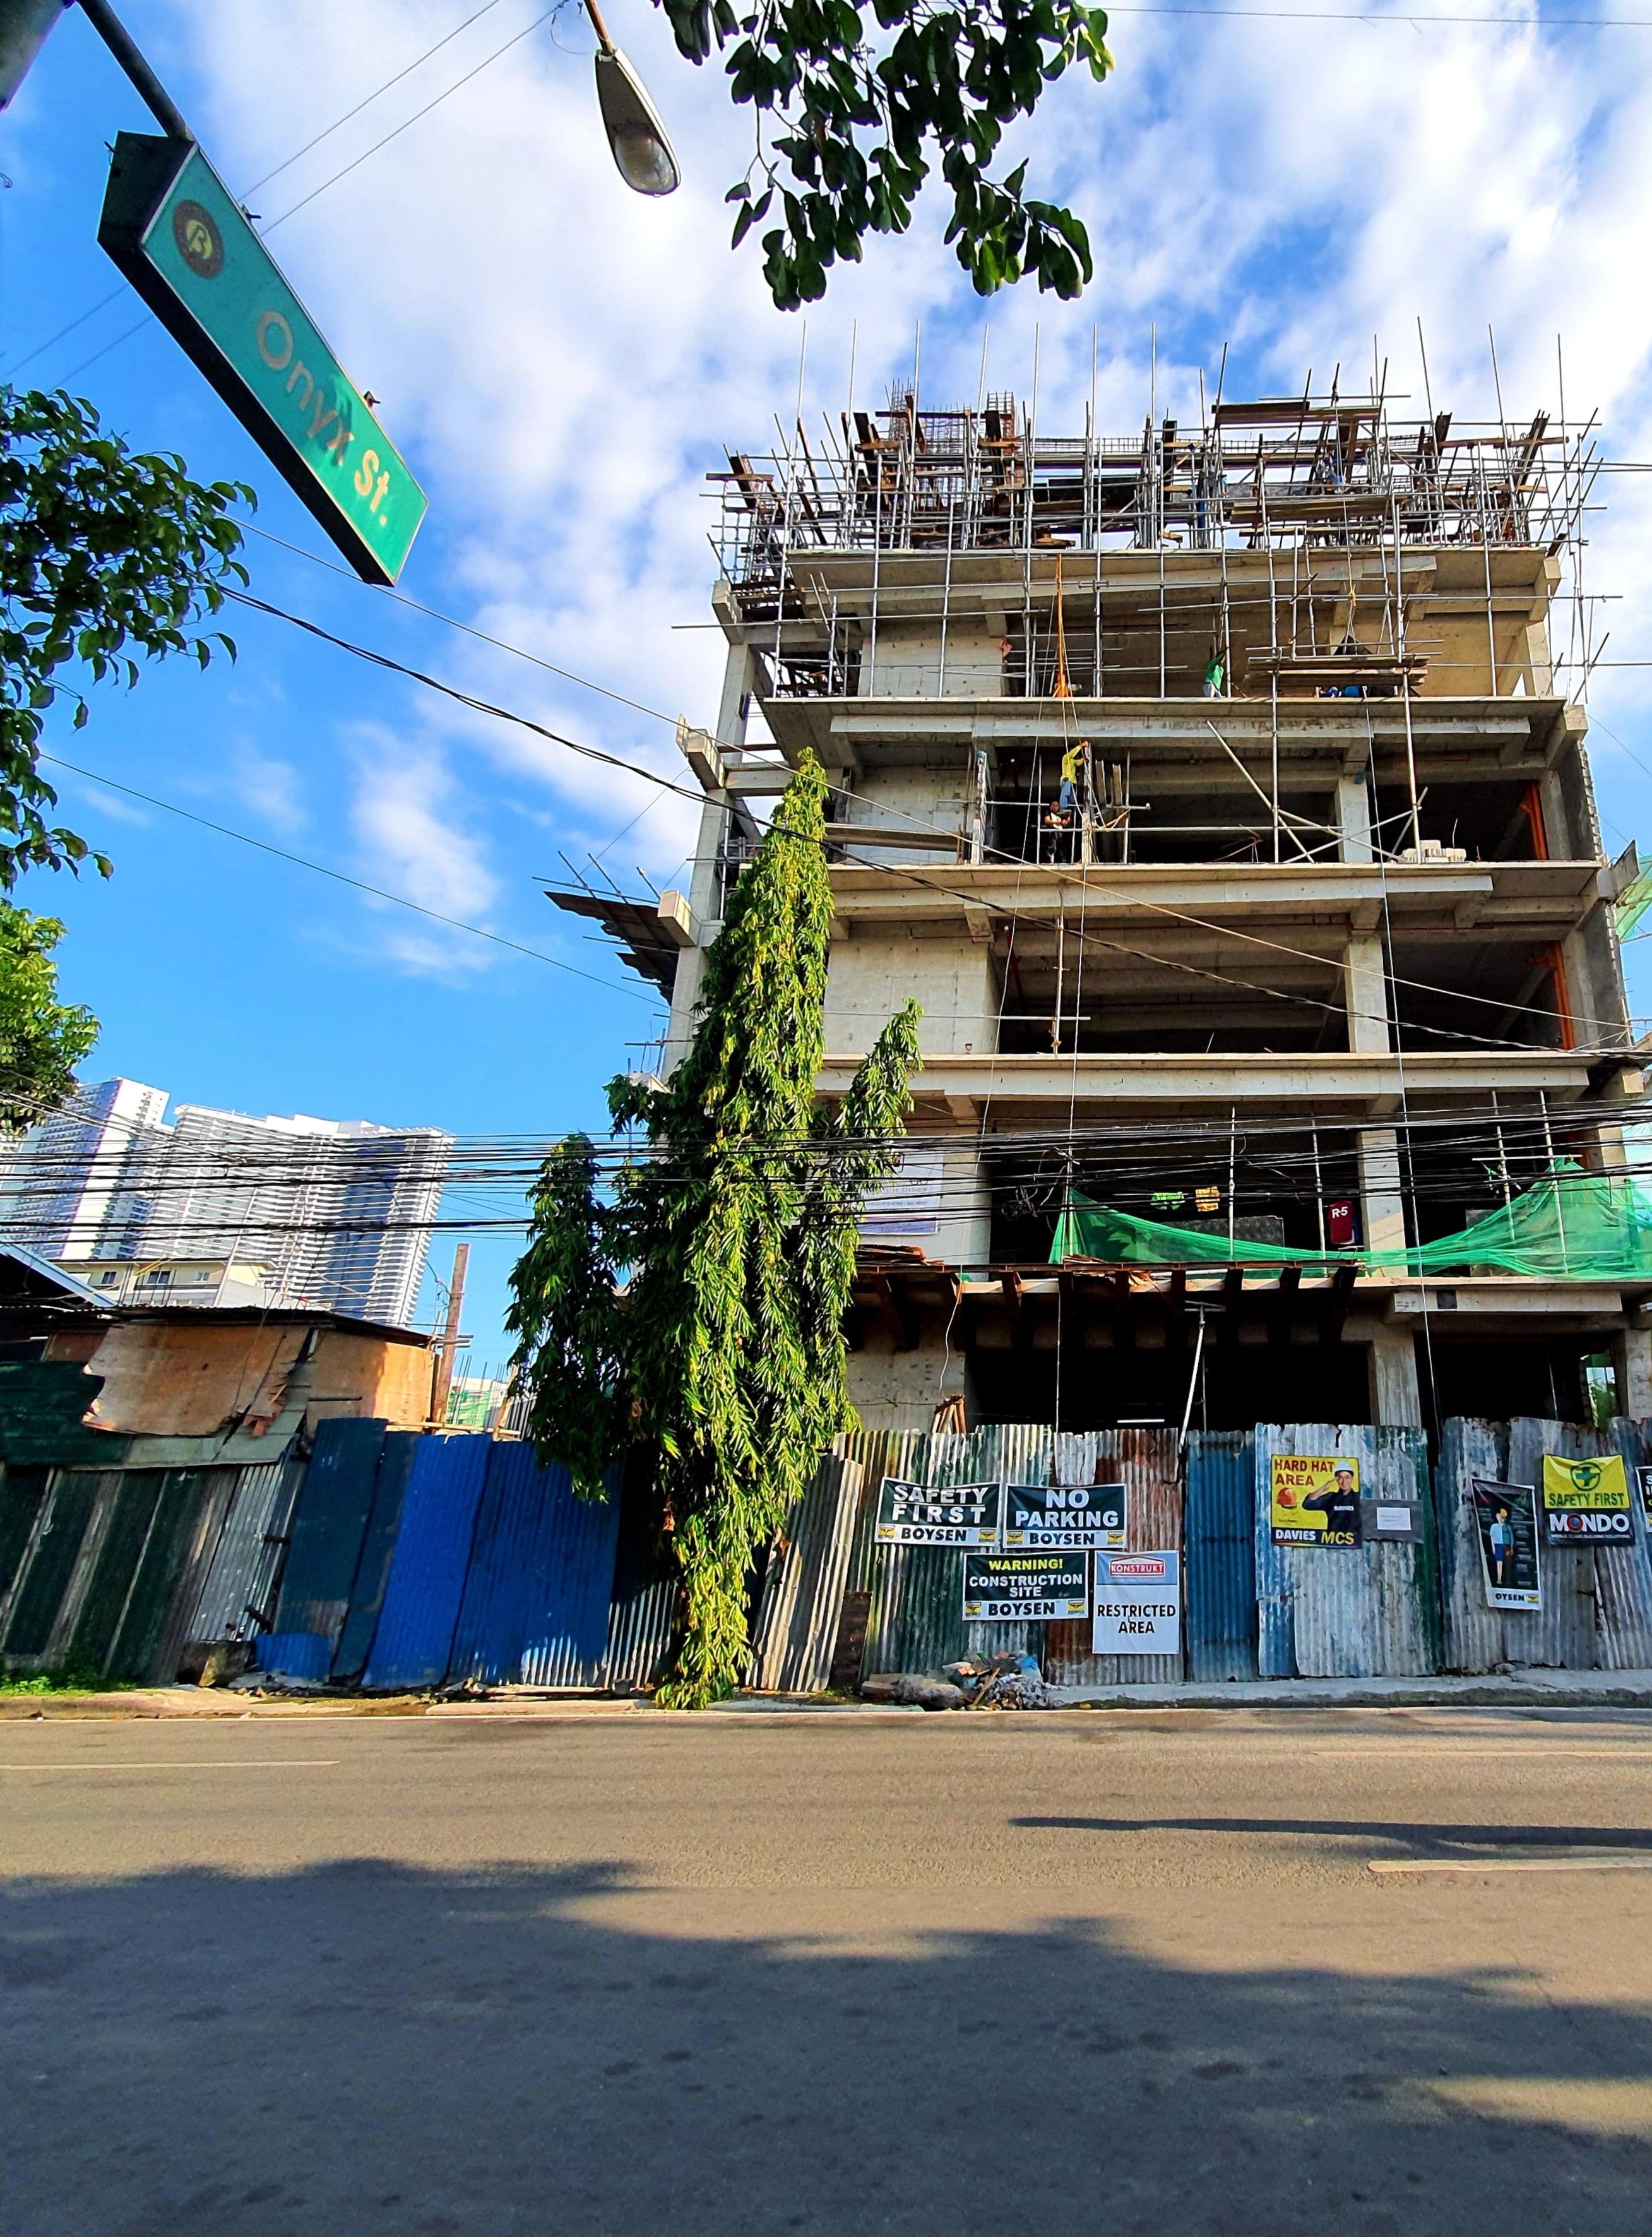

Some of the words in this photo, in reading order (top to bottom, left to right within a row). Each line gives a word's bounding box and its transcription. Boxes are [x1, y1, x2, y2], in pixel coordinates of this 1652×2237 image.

[256, 308, 355, 468] Onyx
[353, 449, 390, 527] St.
[1331, 1206, 1348, 1219] R-5
[1274, 1459, 1307, 1472] HARD
[1311, 1460, 1335, 1472] HAT
[1275, 1473, 1315, 1486] AREA
[893, 1485, 989, 1505] SAFETY
[1045, 1489, 1090, 1508] NO
[1548, 1493, 1590, 1506] SAFETY
[1595, 1492, 1625, 1506] FIRST
[891, 1503, 987, 1524] FIRST
[1015, 1510, 1119, 1528] PARKING
[1549, 1513, 1630, 1533] MONDO
[901, 1527, 968, 1542] BOYSEN
[1029, 1532, 1095, 1546] BOYSEN
[1275, 1529, 1316, 1541] DAVIES
[1321, 1531, 1355, 1545] MCS
[989, 1558, 1064, 1571] WARNING!
[1111, 1565, 1163, 1573] KONSTRUKT
[969, 1573, 1083, 1587] CONSTRUCTION
[1009, 1586, 1042, 1598] SITE
[1494, 1592, 1524, 1602] OYSEN
[988, 1601, 1055, 1616] BOYSEN
[1097, 1604, 1176, 1617] RESTRICTED
[1118, 1621, 1155, 1634] AREA
